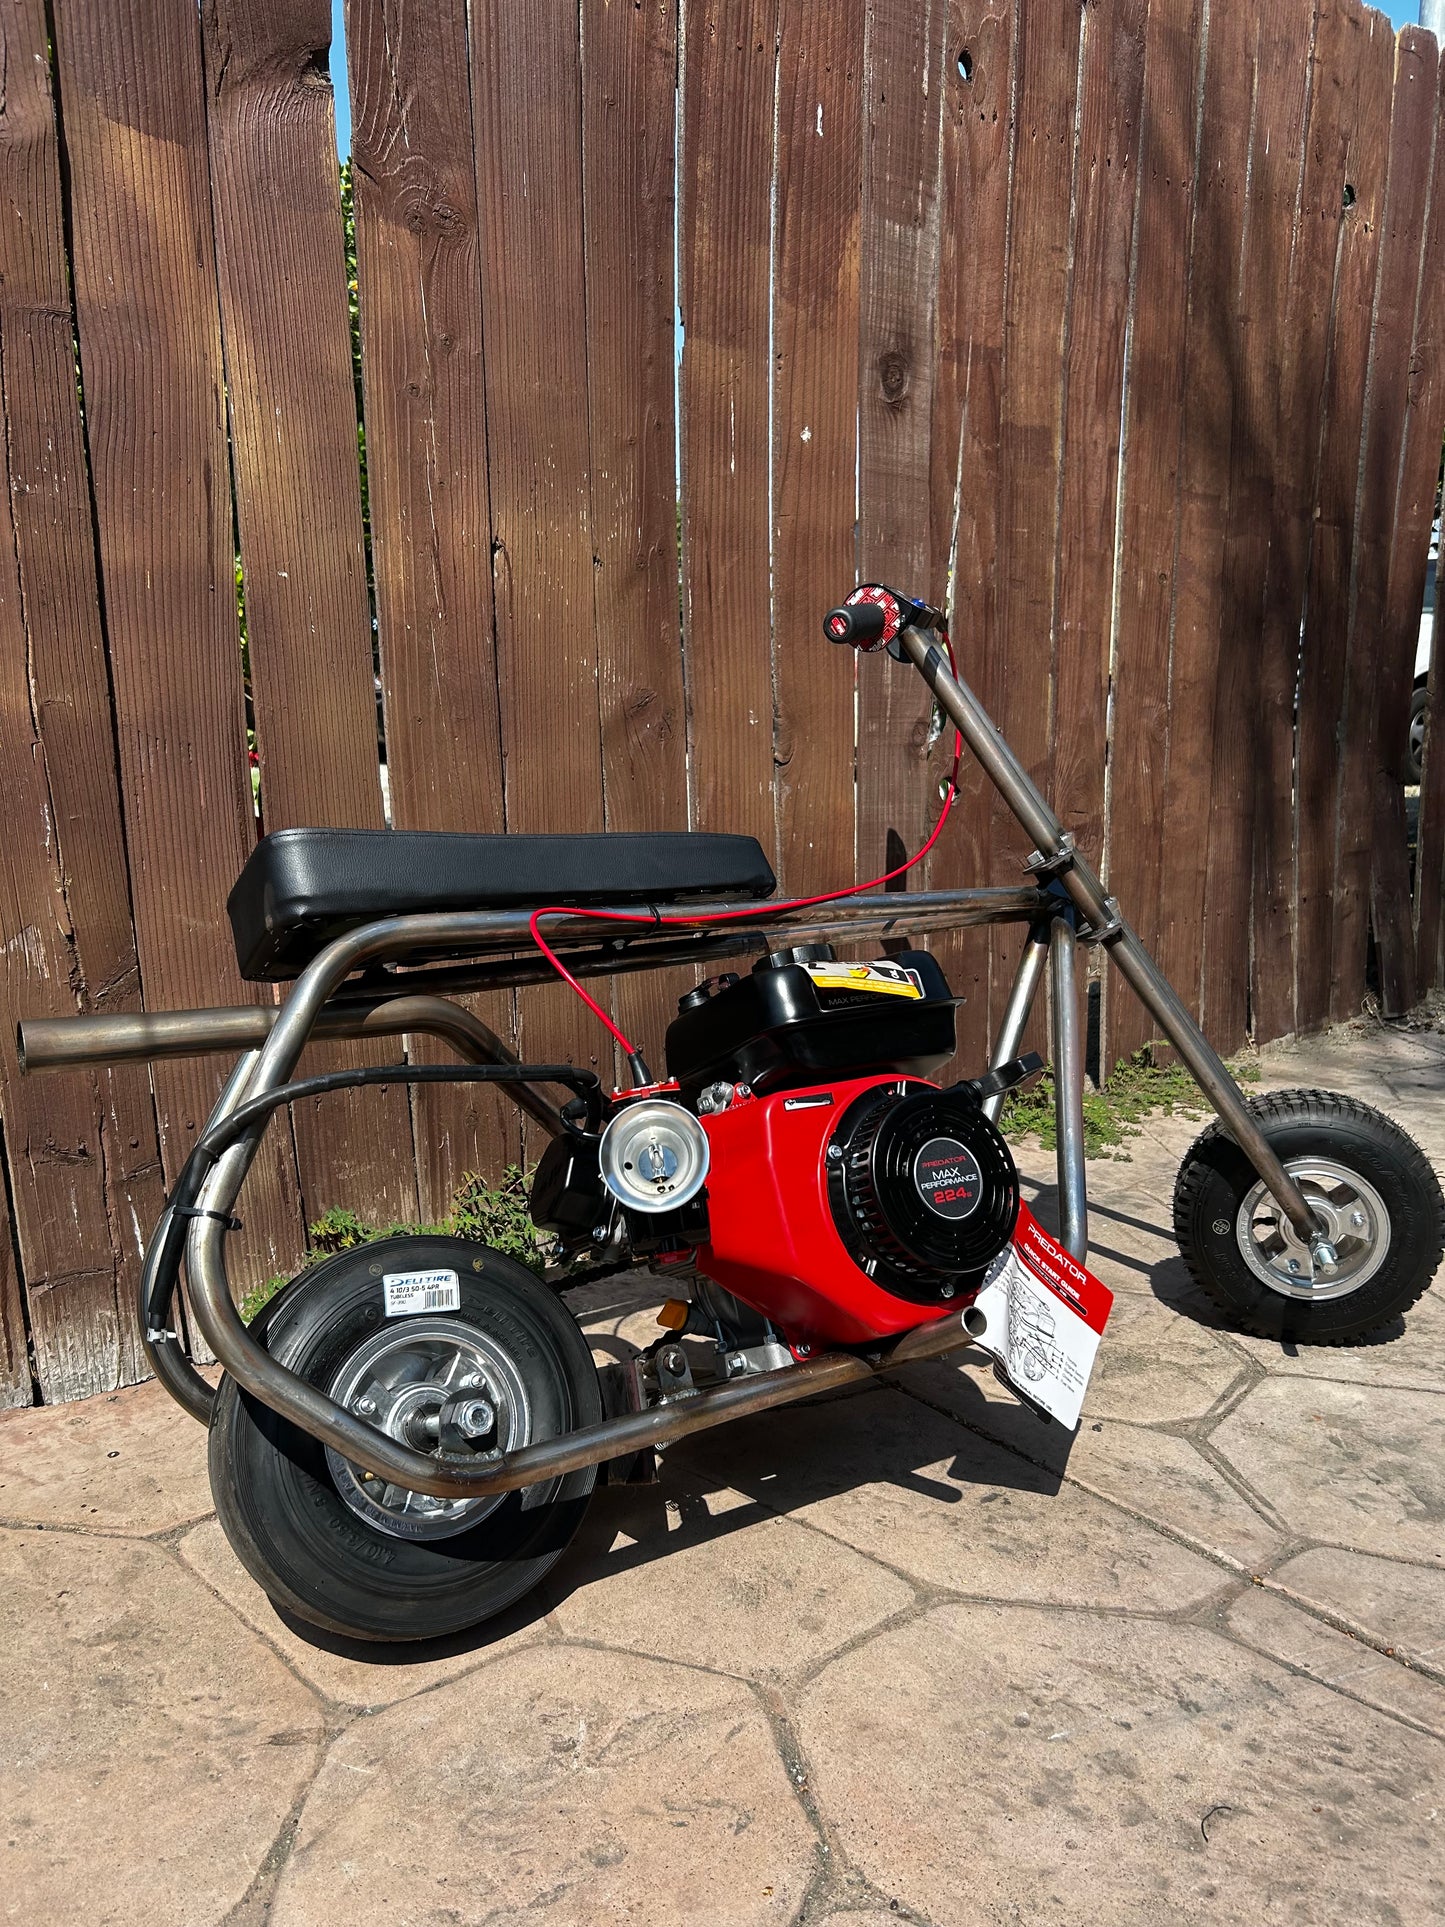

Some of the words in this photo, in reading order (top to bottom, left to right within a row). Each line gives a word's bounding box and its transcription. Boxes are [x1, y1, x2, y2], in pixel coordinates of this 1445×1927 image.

[828, 996, 849, 1006] MAX
[921, 1155, 966, 1168] PREDATOR
[920, 1173, 978, 1190] PERFORMANCE
[932, 1166, 961, 1181] MAX
[1027, 1222, 1087, 1286] PREDATOR
[1023, 1242, 1041, 1264] QUICK
[1040, 1261, 1061, 1281] START
[1060, 1280, 1081, 1300] GUIDE
